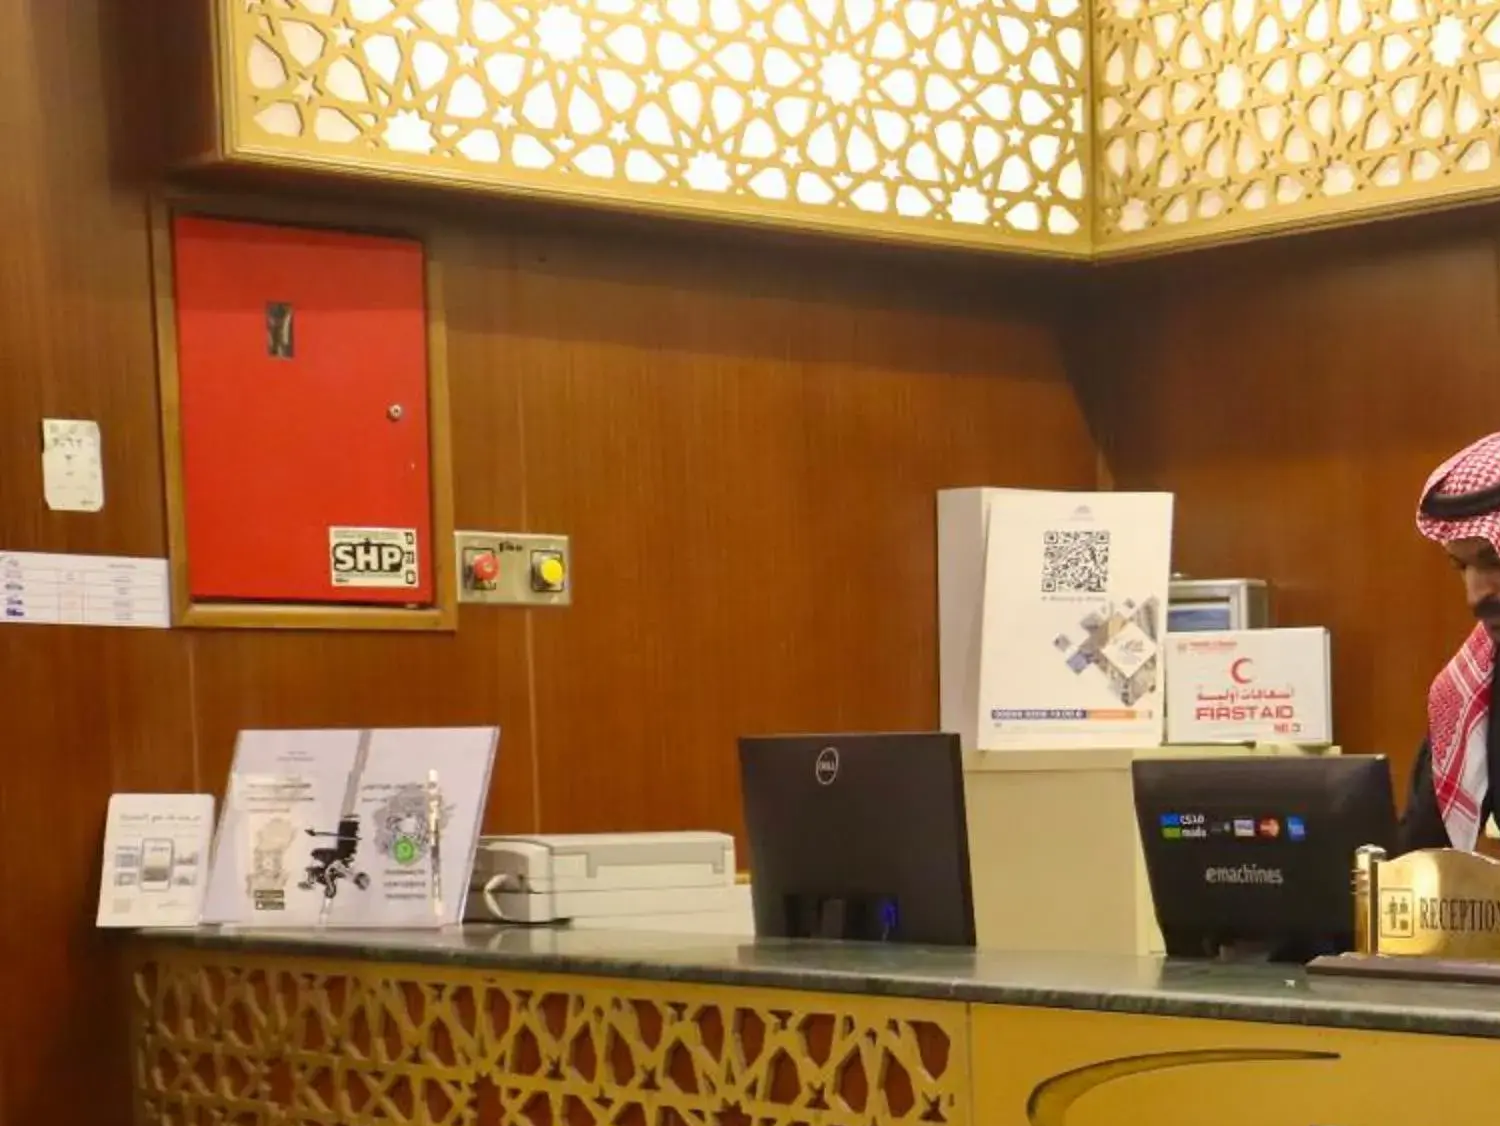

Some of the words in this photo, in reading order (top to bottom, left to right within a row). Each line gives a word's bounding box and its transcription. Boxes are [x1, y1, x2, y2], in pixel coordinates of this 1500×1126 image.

[333, 542, 403, 572] SHP
[1195, 705, 1258, 721] FIRST
[1260, 705, 1294, 719] AID
[1205, 863, 1284, 885] emachines
